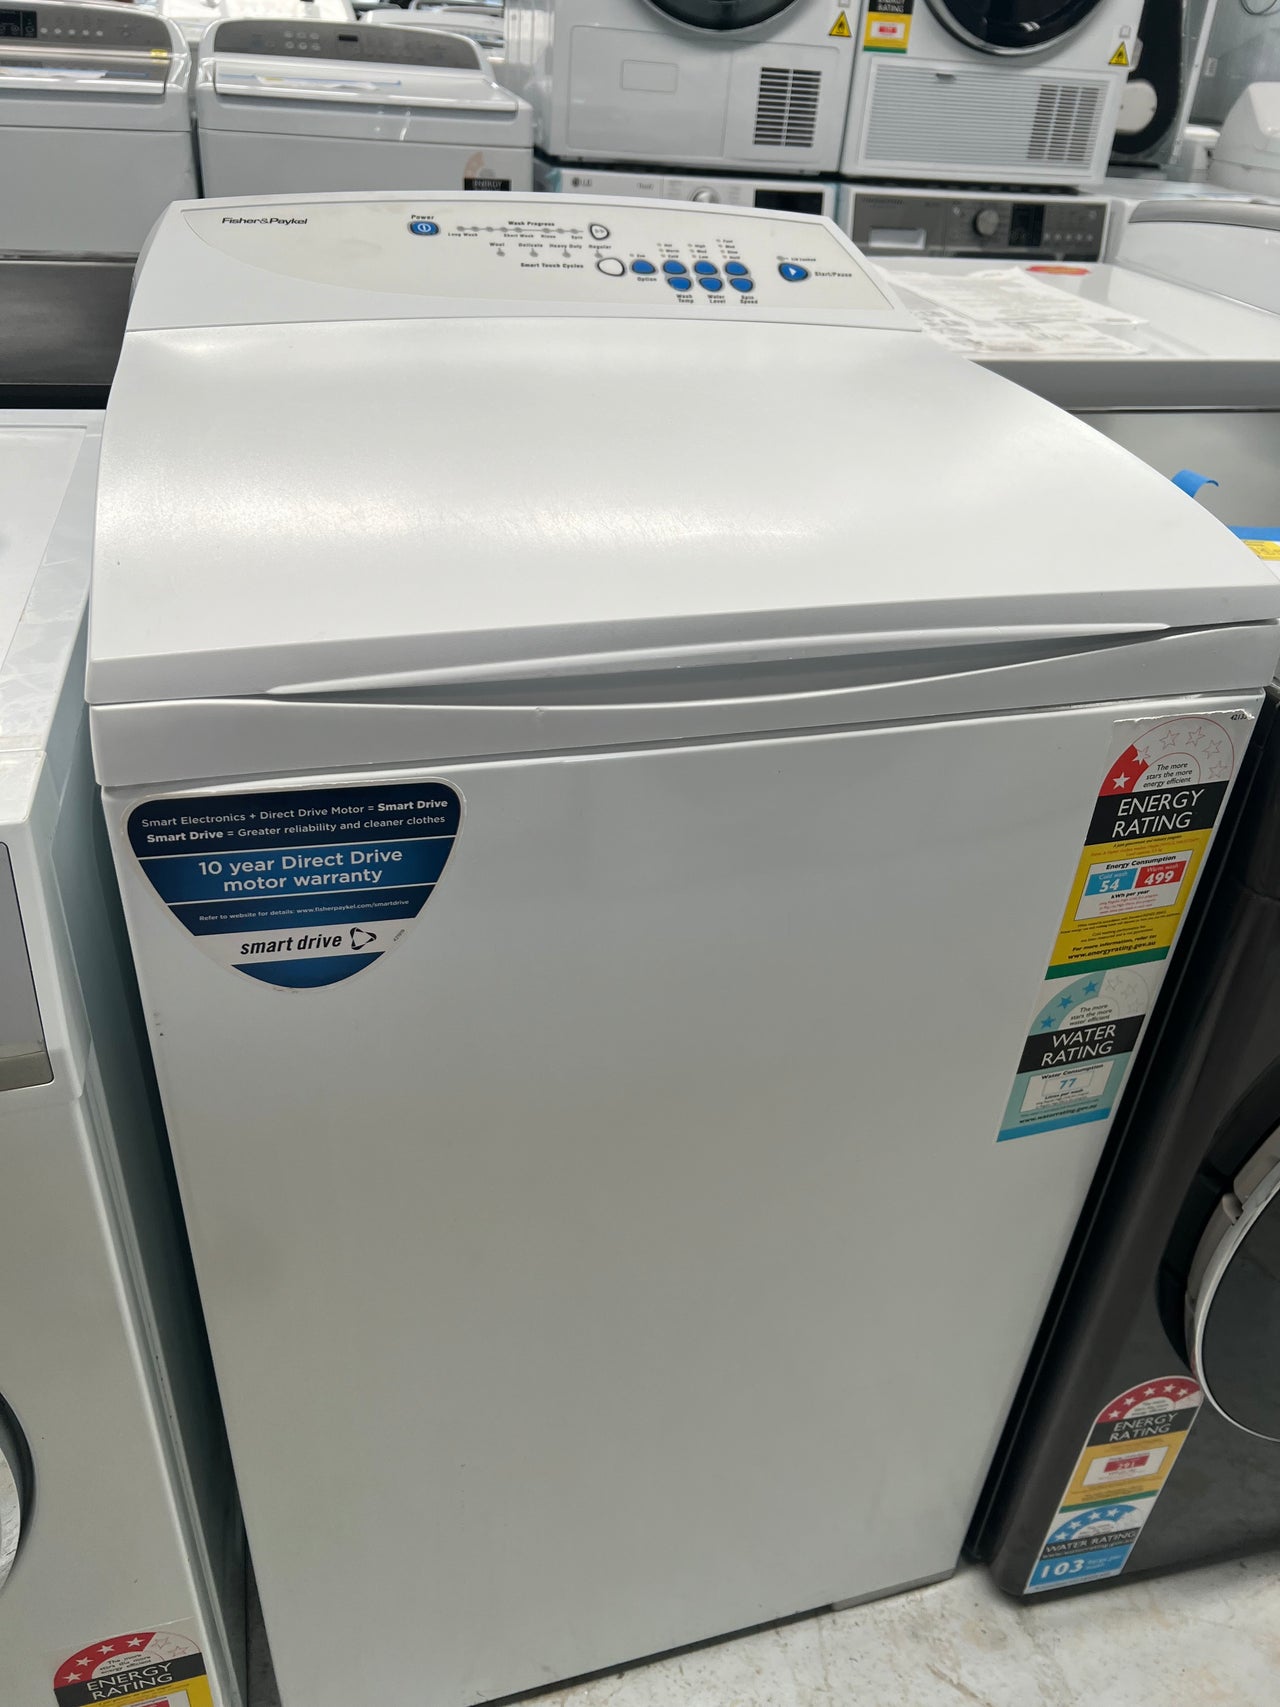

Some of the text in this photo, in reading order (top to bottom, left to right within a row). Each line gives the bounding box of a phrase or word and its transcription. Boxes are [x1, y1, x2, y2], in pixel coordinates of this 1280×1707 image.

[1143, 777, 1191, 788] energy efficient
[141, 816, 177, 828] Smart
[181, 811, 246, 825] Electronics
[260, 809, 295, 820] Direct
[298, 806, 328, 817] Drive
[331, 804, 364, 815] Motor
[377, 801, 414, 812] Smart
[417, 798, 448, 809] Drive
[1117, 788, 1204, 816] ENERGY
[147, 831, 186, 843] Smart
[189, 829, 224, 840] Drive
[238, 826, 281, 837] Greater
[284, 821, 337, 834] reliability
[340, 819, 361, 829] and
[364, 816, 403, 827] cleaner
[406, 814, 446, 825] clothes
[1111, 811, 1192, 838] RATING
[198, 849, 403, 876] 10 year Direct Drive
[1105, 855, 1176, 870] Energy Consumption
[223, 867, 383, 892] motor warranty
[1099, 879, 1120, 892] 54
[1144, 870, 1174, 886] 499
[229, 911, 257, 919] website
[269, 908, 295, 916] details:
[296, 899, 410, 914] www.fisherpaykel.com/smartdrive
[240, 932, 342, 955] smart drive
[1068, 941, 1156, 959] www.energyrating.gov.au
[1053, 1024, 1116, 1048] WATER
[1041, 1040, 1114, 1066] RATING
[1041, 1064, 1104, 1080] Water Consumption
[1060, 1077, 1077, 1090] 77
[1108, 1424, 1172, 1442] RATING
[1113, 1412, 1178, 1432] ENERGY
[1045, 1540, 1087, 1553] WATER
[1091, 1530, 1136, 1545] RATING
[1041, 1559, 1085, 1578] 103
[86, 1662, 172, 1691] ENERGY
[92, 1673, 173, 1700] RATING
